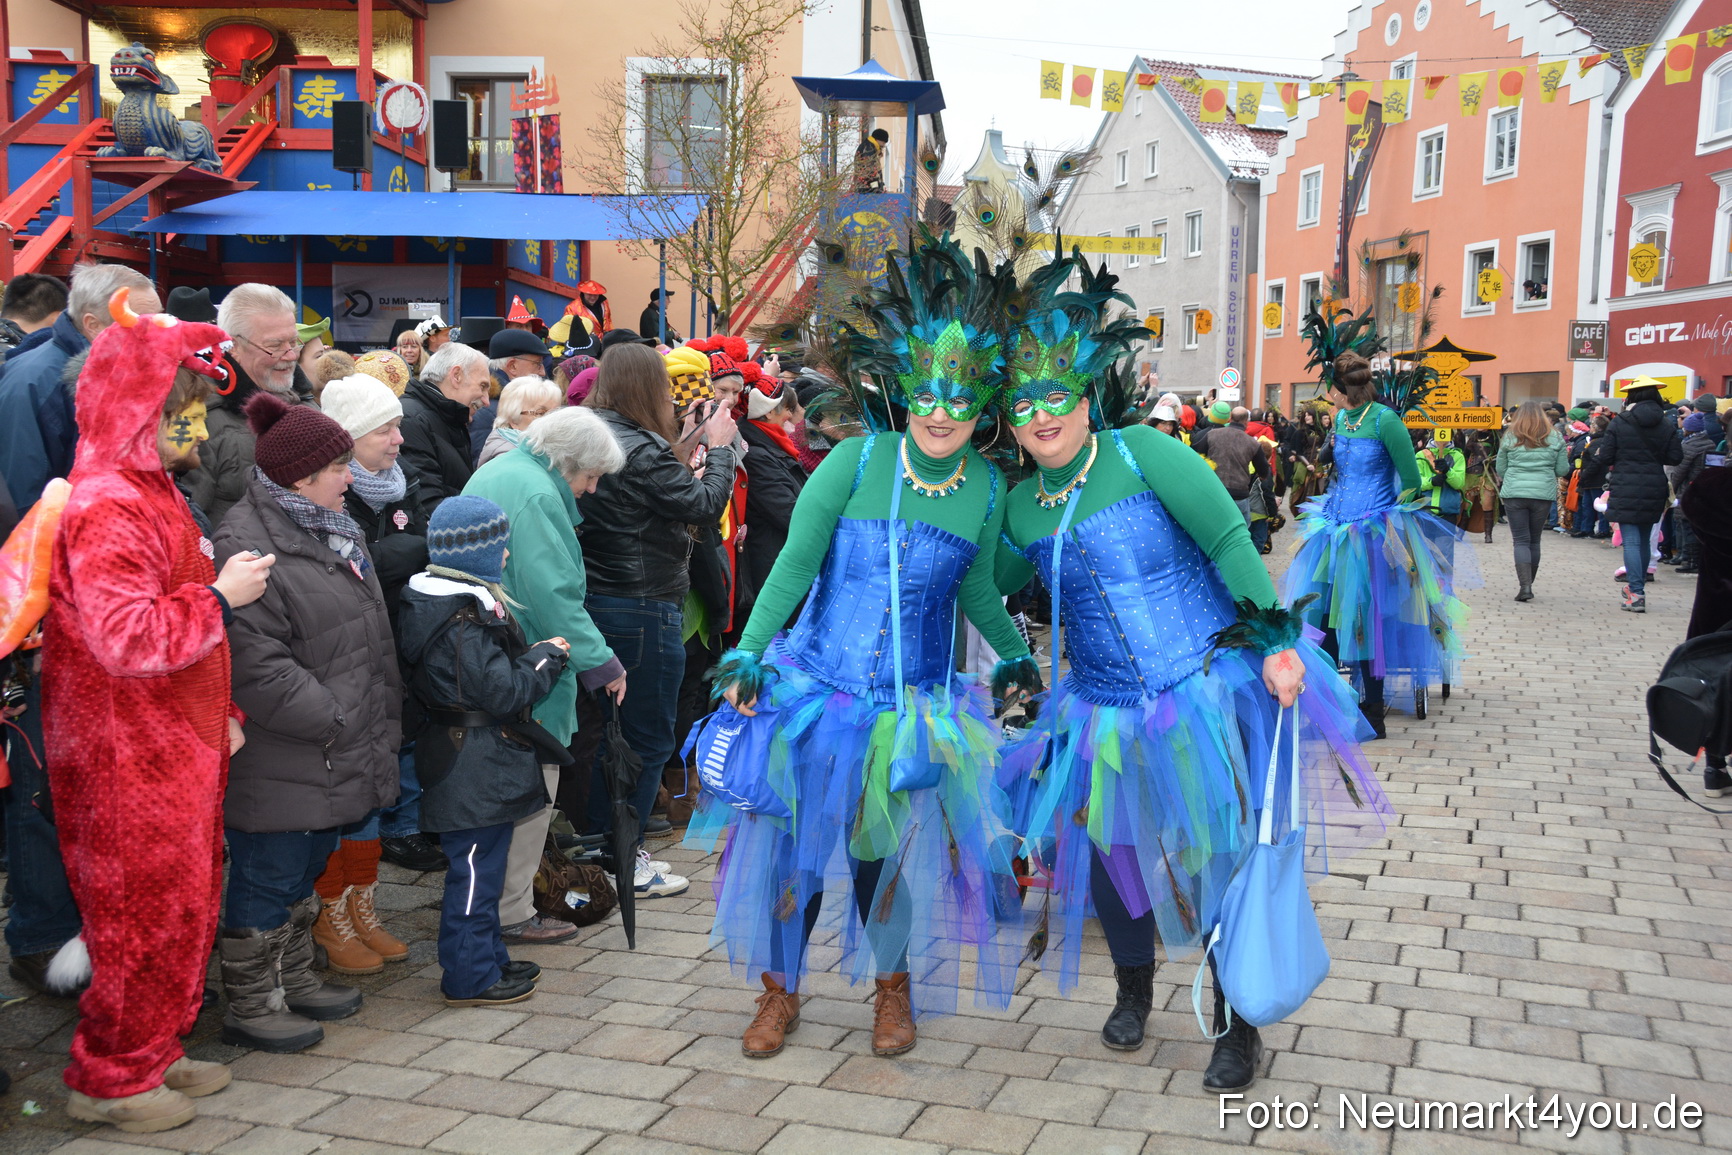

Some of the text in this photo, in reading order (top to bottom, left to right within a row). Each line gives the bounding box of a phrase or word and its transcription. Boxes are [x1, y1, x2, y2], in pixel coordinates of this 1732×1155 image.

[379, 297, 390, 305] DJ
[392, 297, 413, 305] Mike
[1226, 227, 1239, 368] UHREN SCHMUCK
[1574, 325, 1603, 339] CAFÉ
[1691, 314, 1723, 341] Mode
[1454, 413, 1460, 422] &
[1463, 413, 1491, 422] Friends
[1439, 429, 1446, 439] 6
